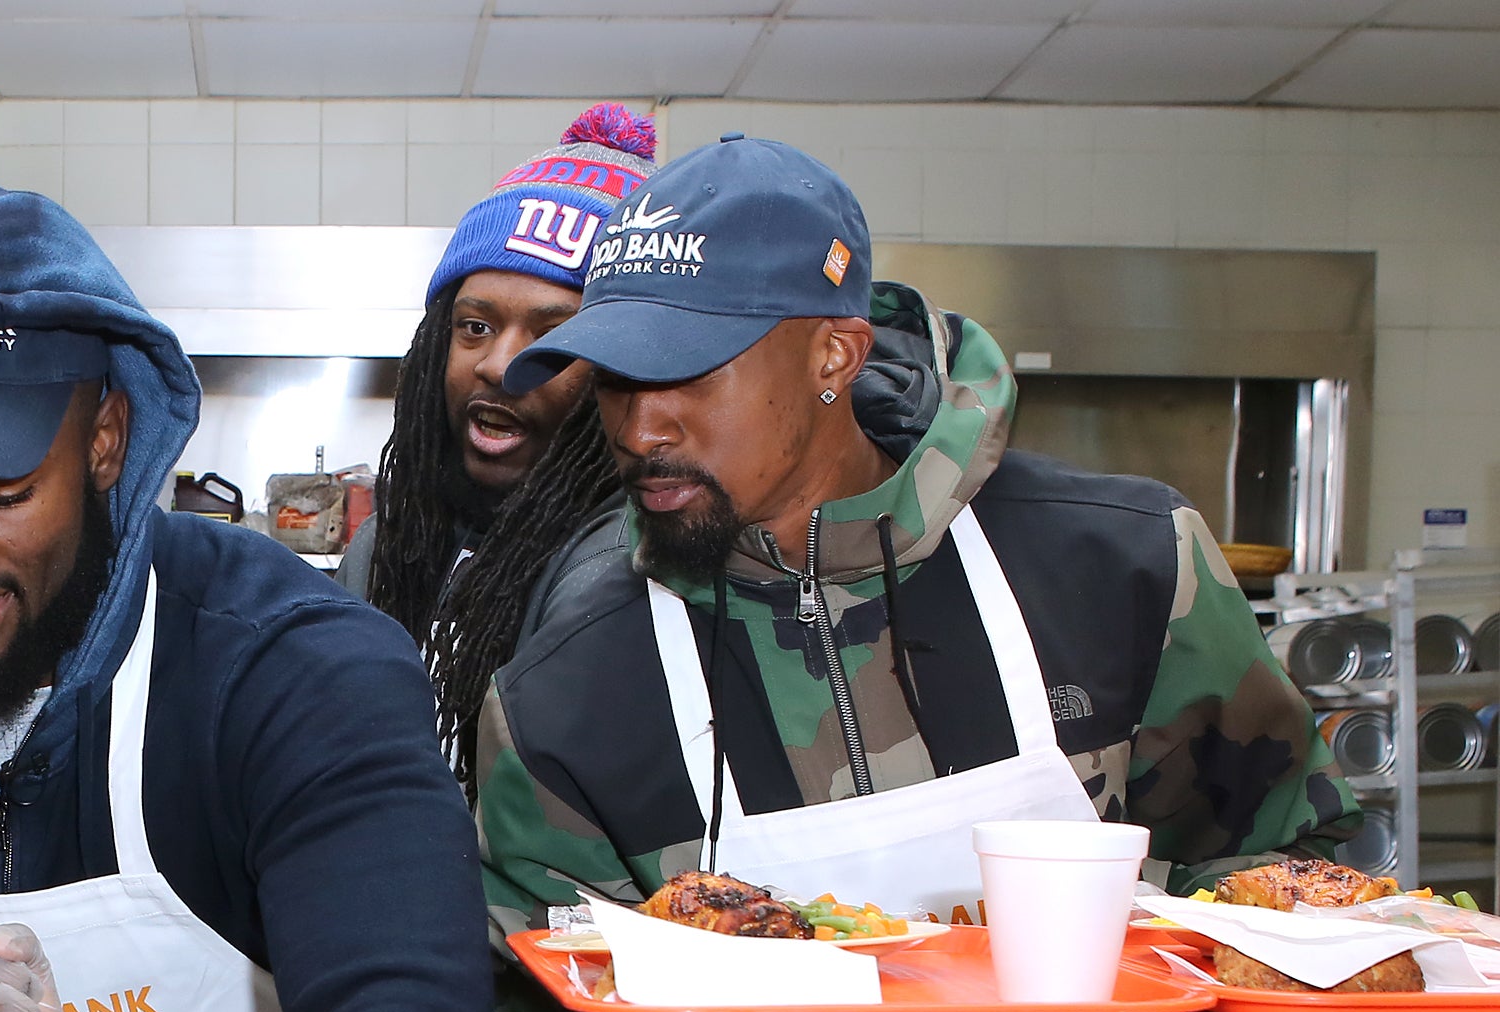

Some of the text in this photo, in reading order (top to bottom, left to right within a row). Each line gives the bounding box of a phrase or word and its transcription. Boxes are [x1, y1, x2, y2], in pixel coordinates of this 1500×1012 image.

[588, 232, 707, 273] OOD BANK
[614, 261, 653, 275] YORK
[660, 262, 701, 277] CITY
[1049, 685, 1066, 698] HE
